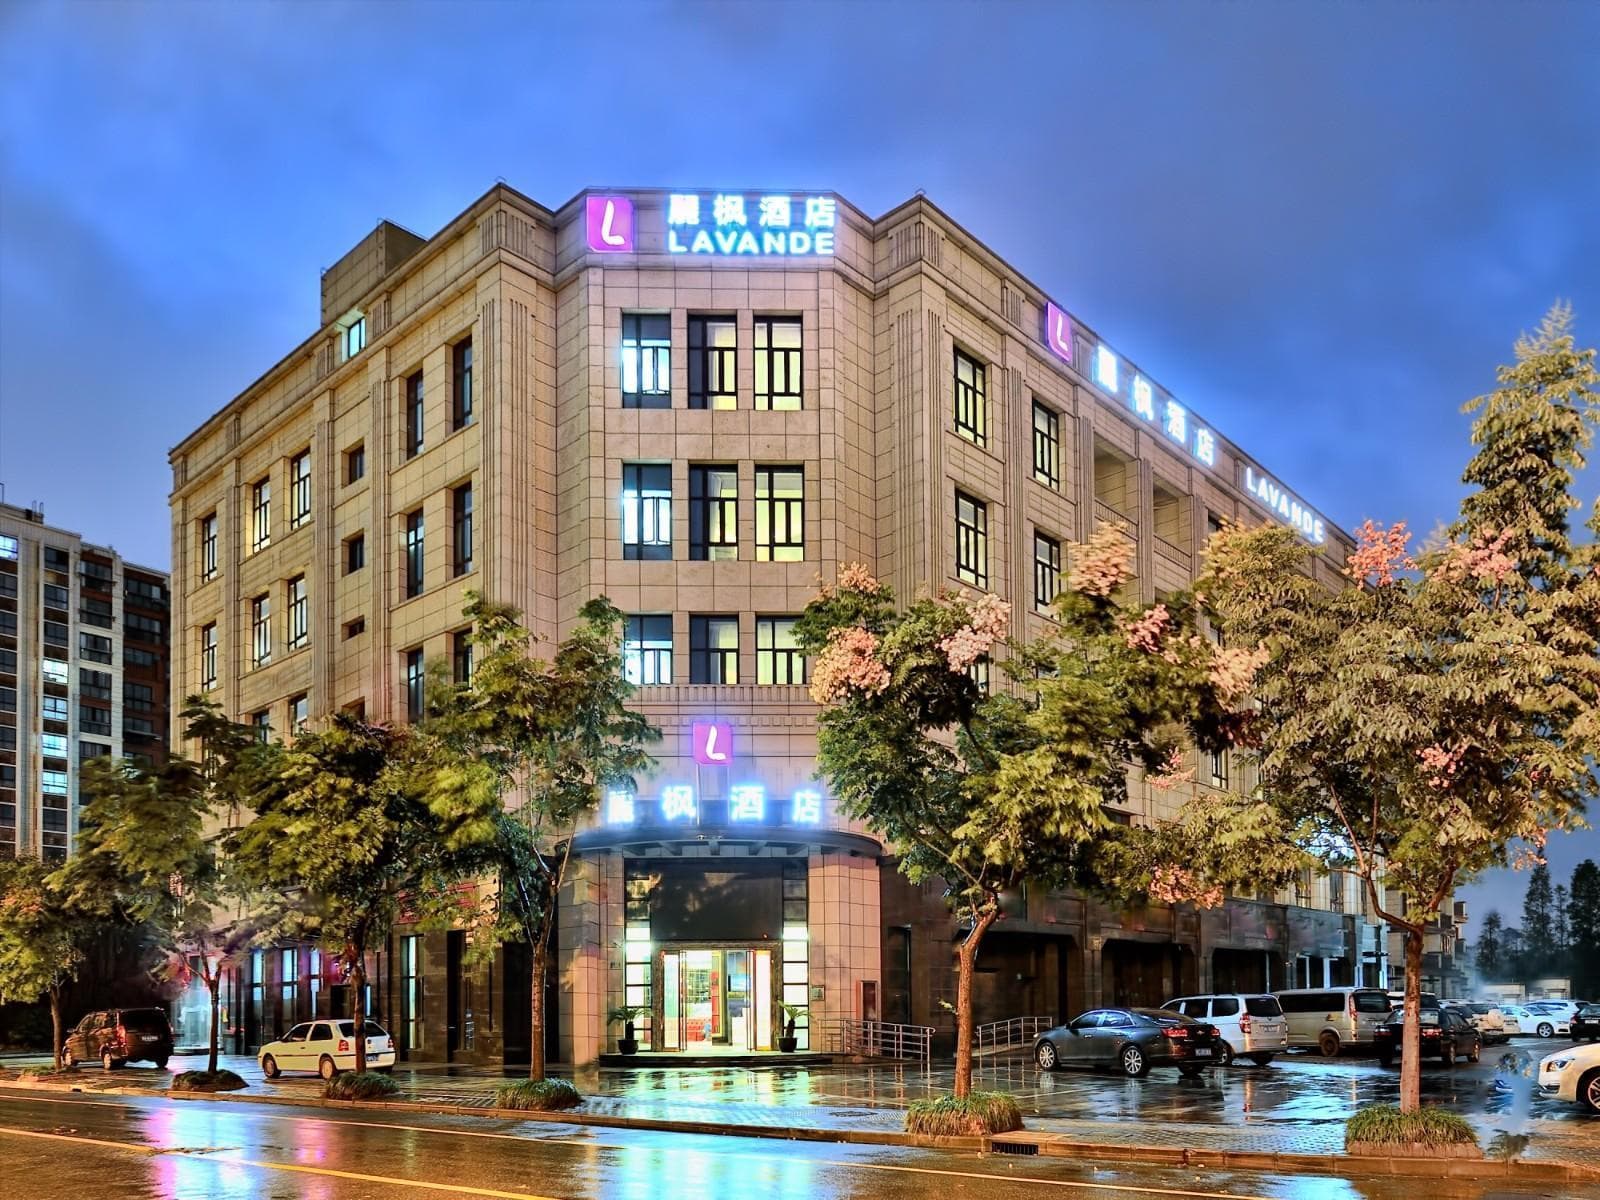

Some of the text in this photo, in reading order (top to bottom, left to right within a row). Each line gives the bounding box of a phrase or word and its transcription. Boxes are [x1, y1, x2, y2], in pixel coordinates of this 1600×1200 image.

[668, 231, 835, 255] LAVANDE
[1096, 344, 1215, 467] 枫酒店
[1245, 467, 1324, 543] LAVANDE
[607, 786, 822, 823] 枫酒店
